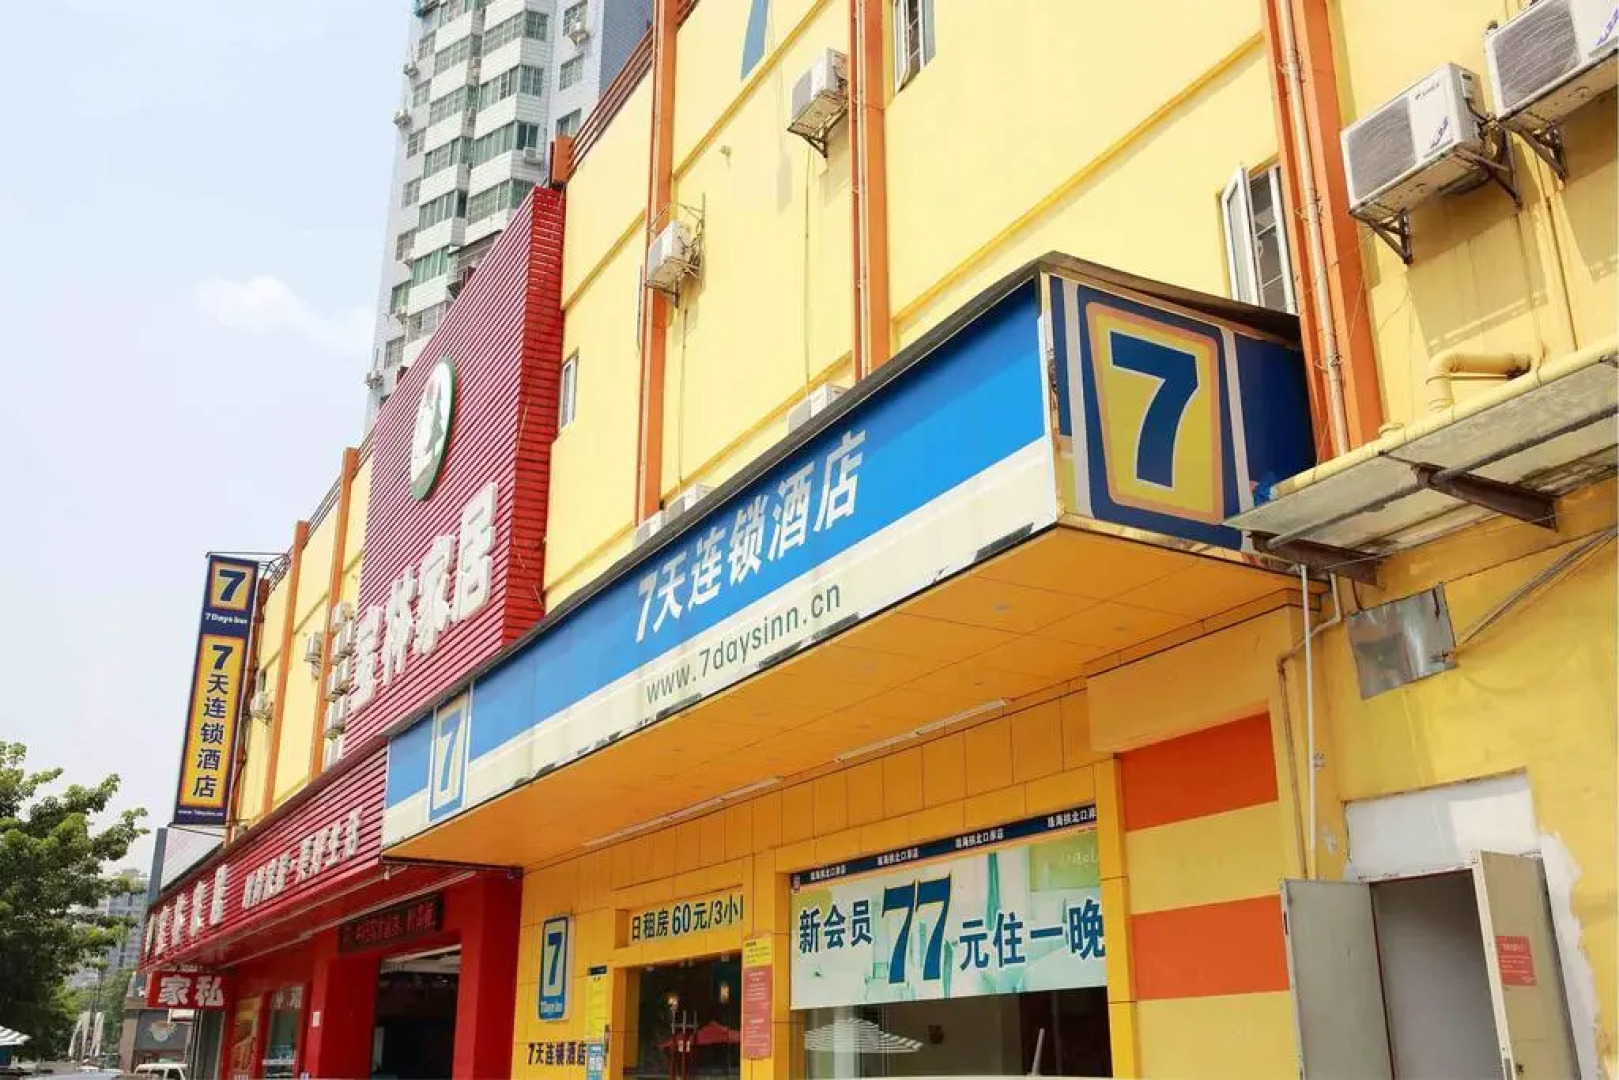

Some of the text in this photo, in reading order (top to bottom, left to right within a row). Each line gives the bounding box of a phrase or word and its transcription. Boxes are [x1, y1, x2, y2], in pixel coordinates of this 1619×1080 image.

[1109, 329, 1200, 490] 7
[636, 429, 867, 645] 7天连锁酒店
[219, 568, 246, 602] 7
[646, 584, 842, 704] www.7daysinn.cn
[192, 644, 233, 798] 7天连锁酒店
[440, 707, 463, 794] 7
[157, 974, 225, 1007] 家私
[547, 932, 563, 986] 7
[527, 1040, 587, 1067] 7天连锁酒店
